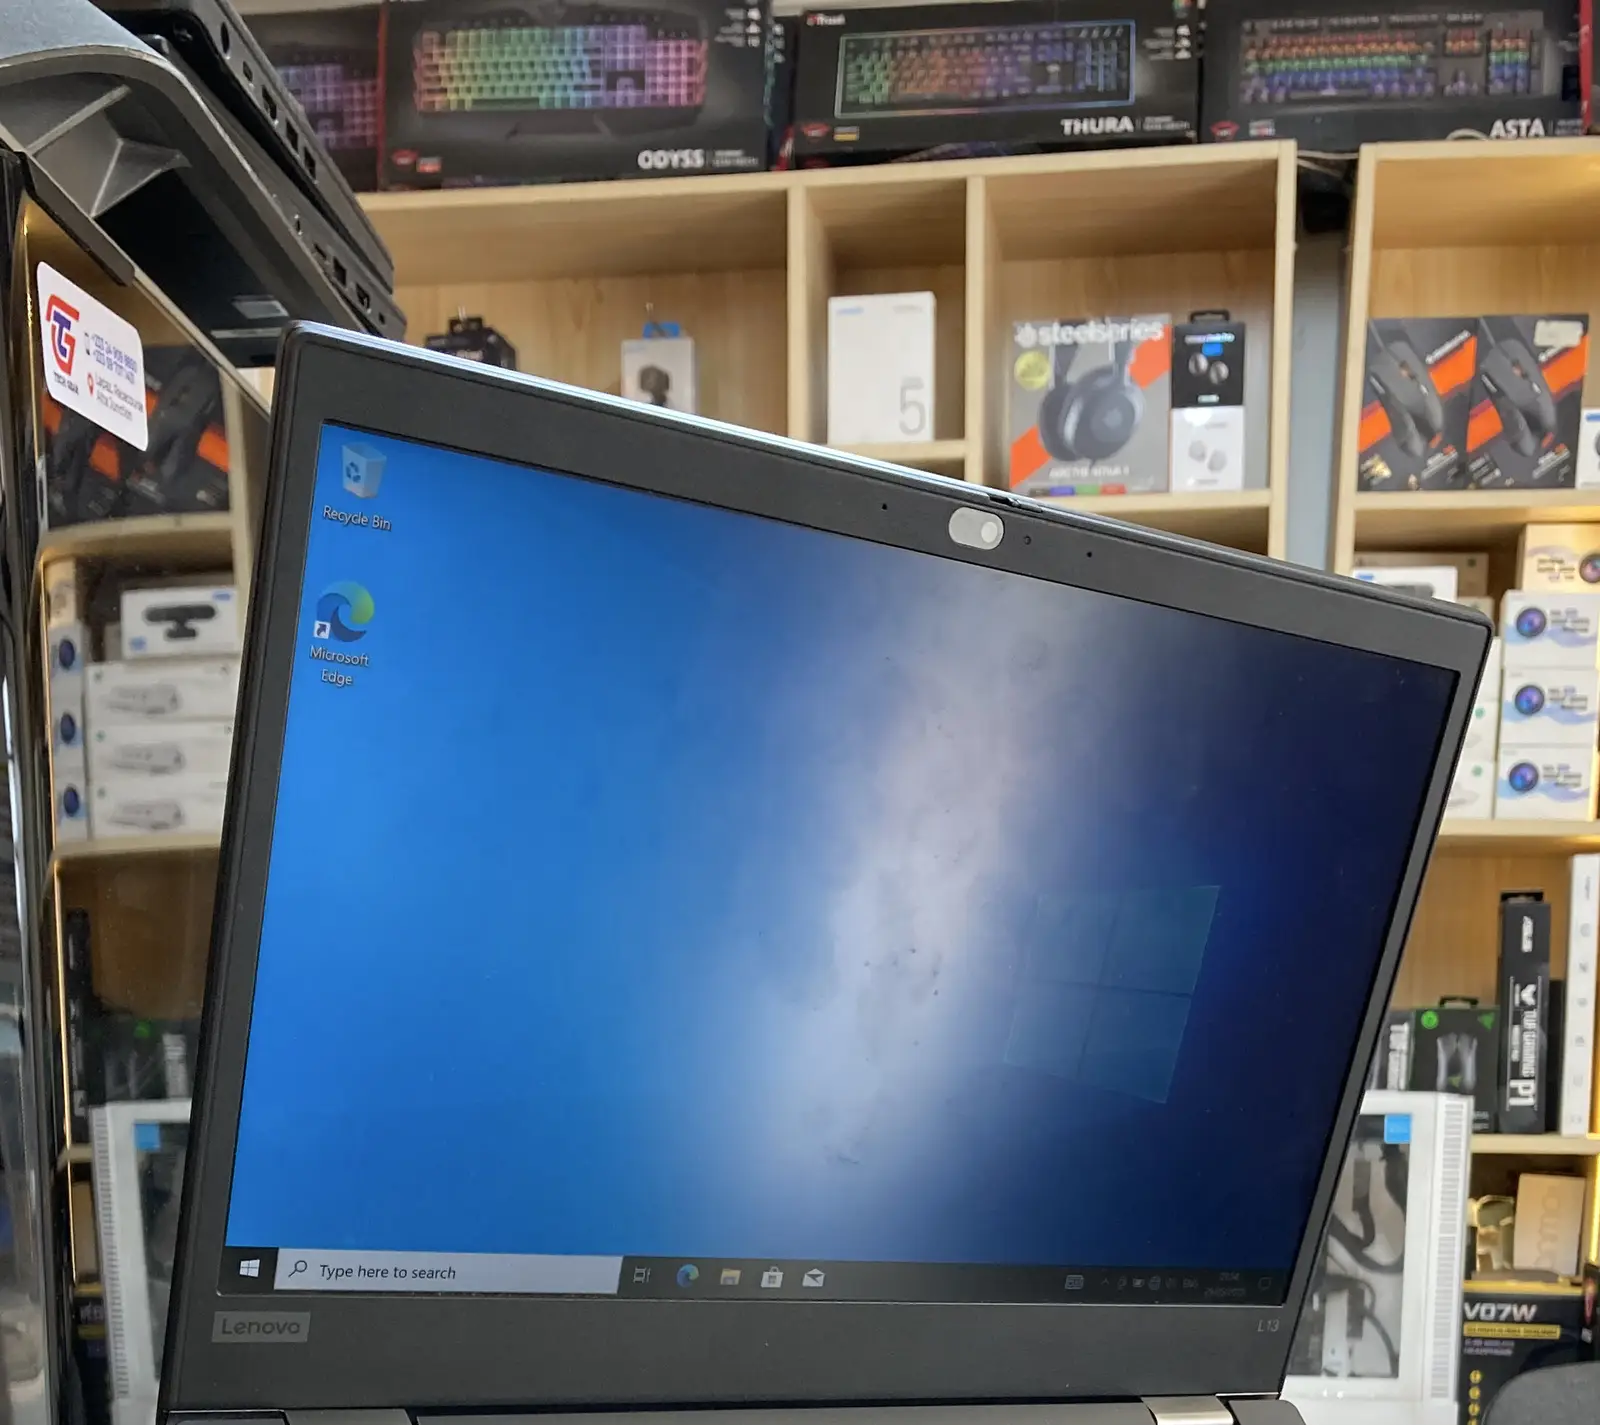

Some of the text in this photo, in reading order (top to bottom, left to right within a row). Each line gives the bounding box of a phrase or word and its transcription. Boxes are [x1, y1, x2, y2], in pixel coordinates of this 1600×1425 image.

[1060, 116, 1134, 135] THURA
[1490, 117, 1546, 138] ASTA
[1038, 317, 1164, 347] steelseries
[900, 377, 927, 435] 5
[323, 505, 392, 531] Recycle Bin
[310, 645, 369, 667] Microsoft
[321, 668, 353, 687] Edge
[320, 1264, 457, 1281] Type here to search
[222, 1318, 300, 1336] Lenovo
[1257, 1320, 1280, 1332] L13
